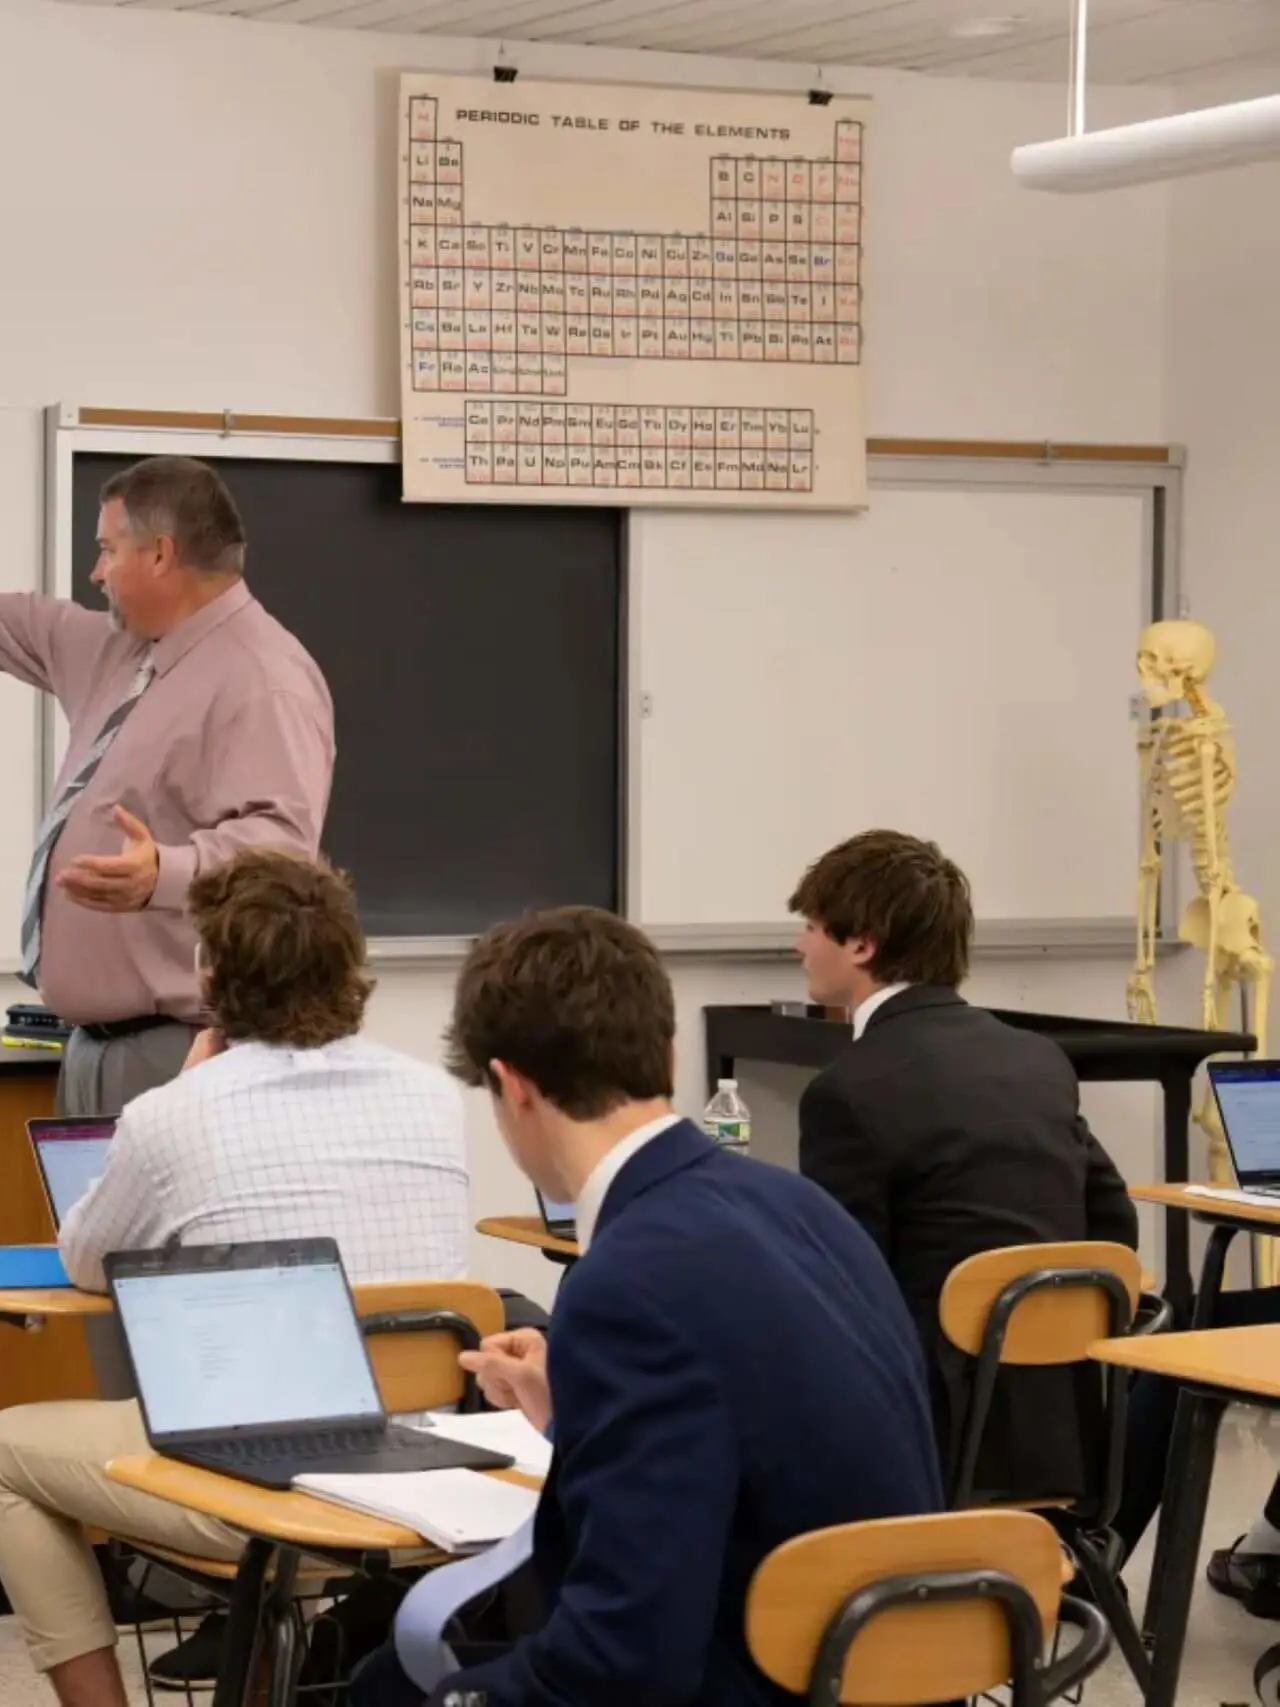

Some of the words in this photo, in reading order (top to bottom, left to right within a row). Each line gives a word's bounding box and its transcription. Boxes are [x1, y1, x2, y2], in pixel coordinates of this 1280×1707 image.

[456, 109, 540, 125] PERIODIC
[551, 116, 608, 130] TABLE
[619, 120, 640, 131] OF
[651, 122, 684, 135] THE
[694, 124, 790, 140] ELEMENTS
